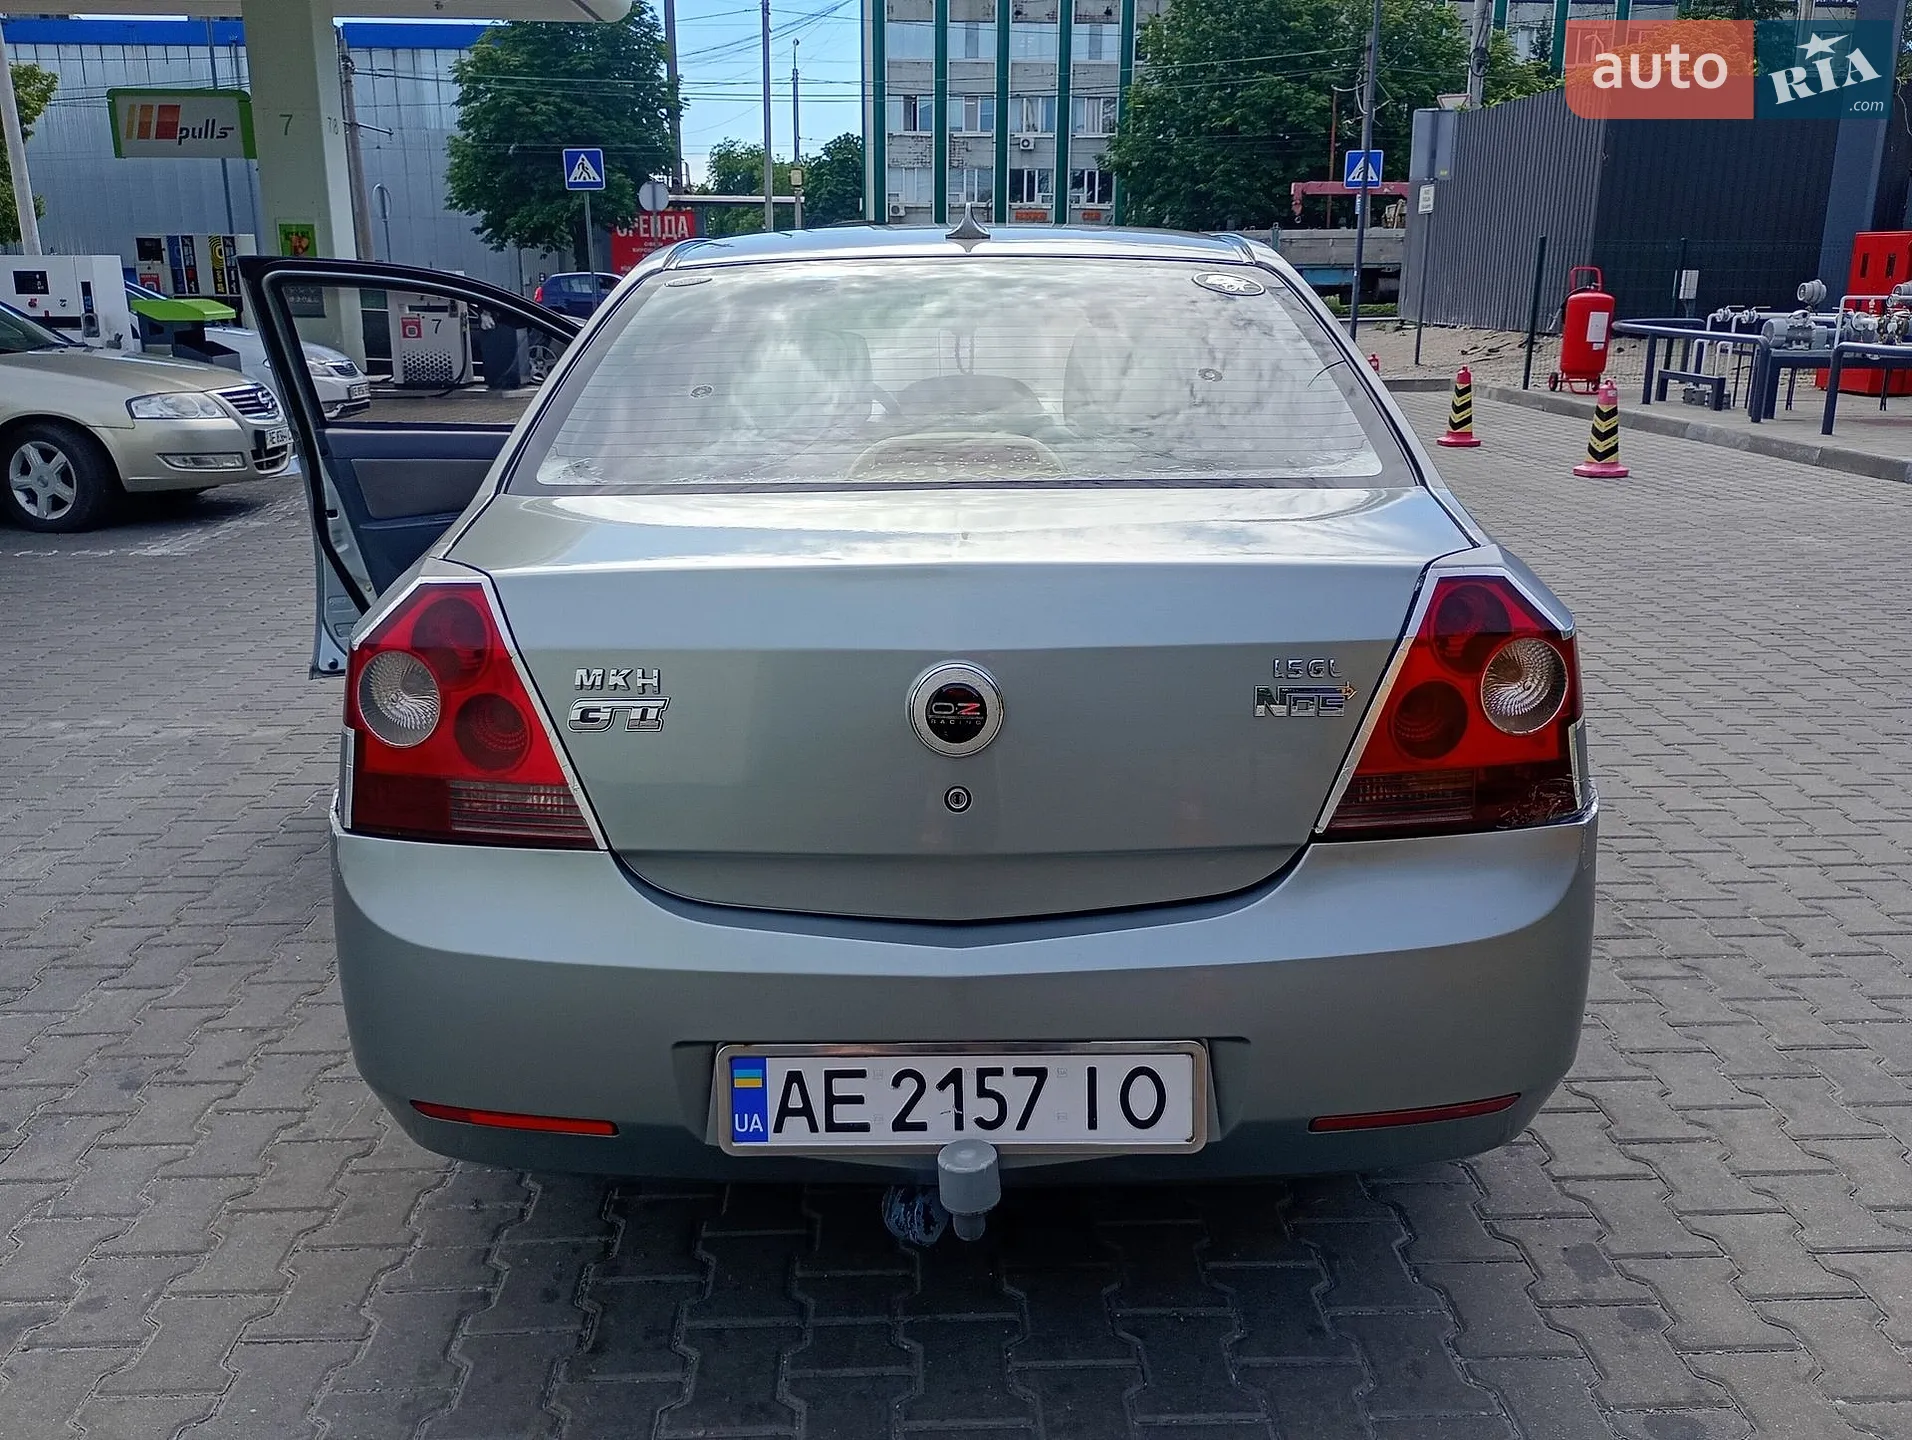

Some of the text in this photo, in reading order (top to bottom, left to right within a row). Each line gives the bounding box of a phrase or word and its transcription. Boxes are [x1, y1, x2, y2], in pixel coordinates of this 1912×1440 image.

[177, 118, 235, 146] pulls
[279, 113, 293, 136] 7
[574, 667, 661, 694] MKH
[772, 1068, 871, 1134] AE
[890, 1067, 1049, 1132] 2157
[734, 1113, 763, 1134] UA
